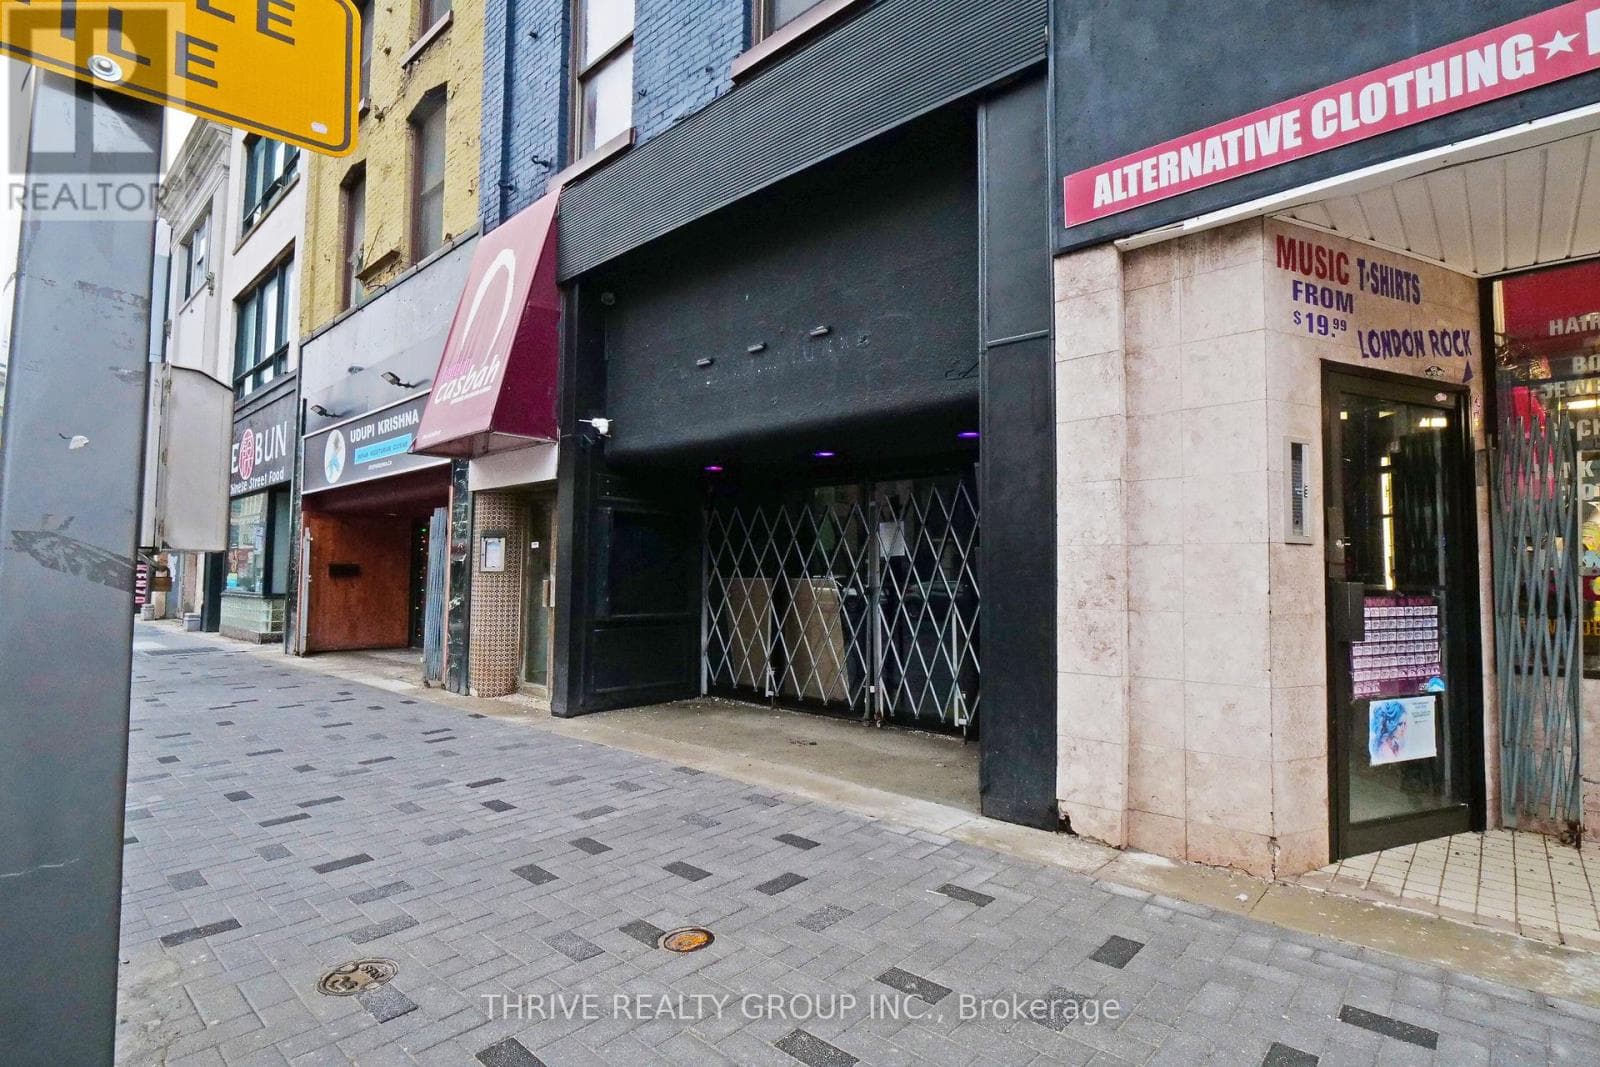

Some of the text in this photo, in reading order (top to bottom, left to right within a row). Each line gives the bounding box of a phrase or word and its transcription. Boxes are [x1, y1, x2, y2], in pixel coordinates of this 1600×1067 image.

[1092, 33, 1536, 209] ALTERNATIVE CLOTHING
[1276, 235, 1350, 286] MUSIC
[1291, 279, 1354, 315] FROM
[1357, 328, 1473, 360] LONDON ROCK
[254, 420, 288, 466] BUN
[350, 424, 375, 443] UDUPI
[377, 408, 420, 435] KRISHNA
[268, 466, 285, 485] Food
